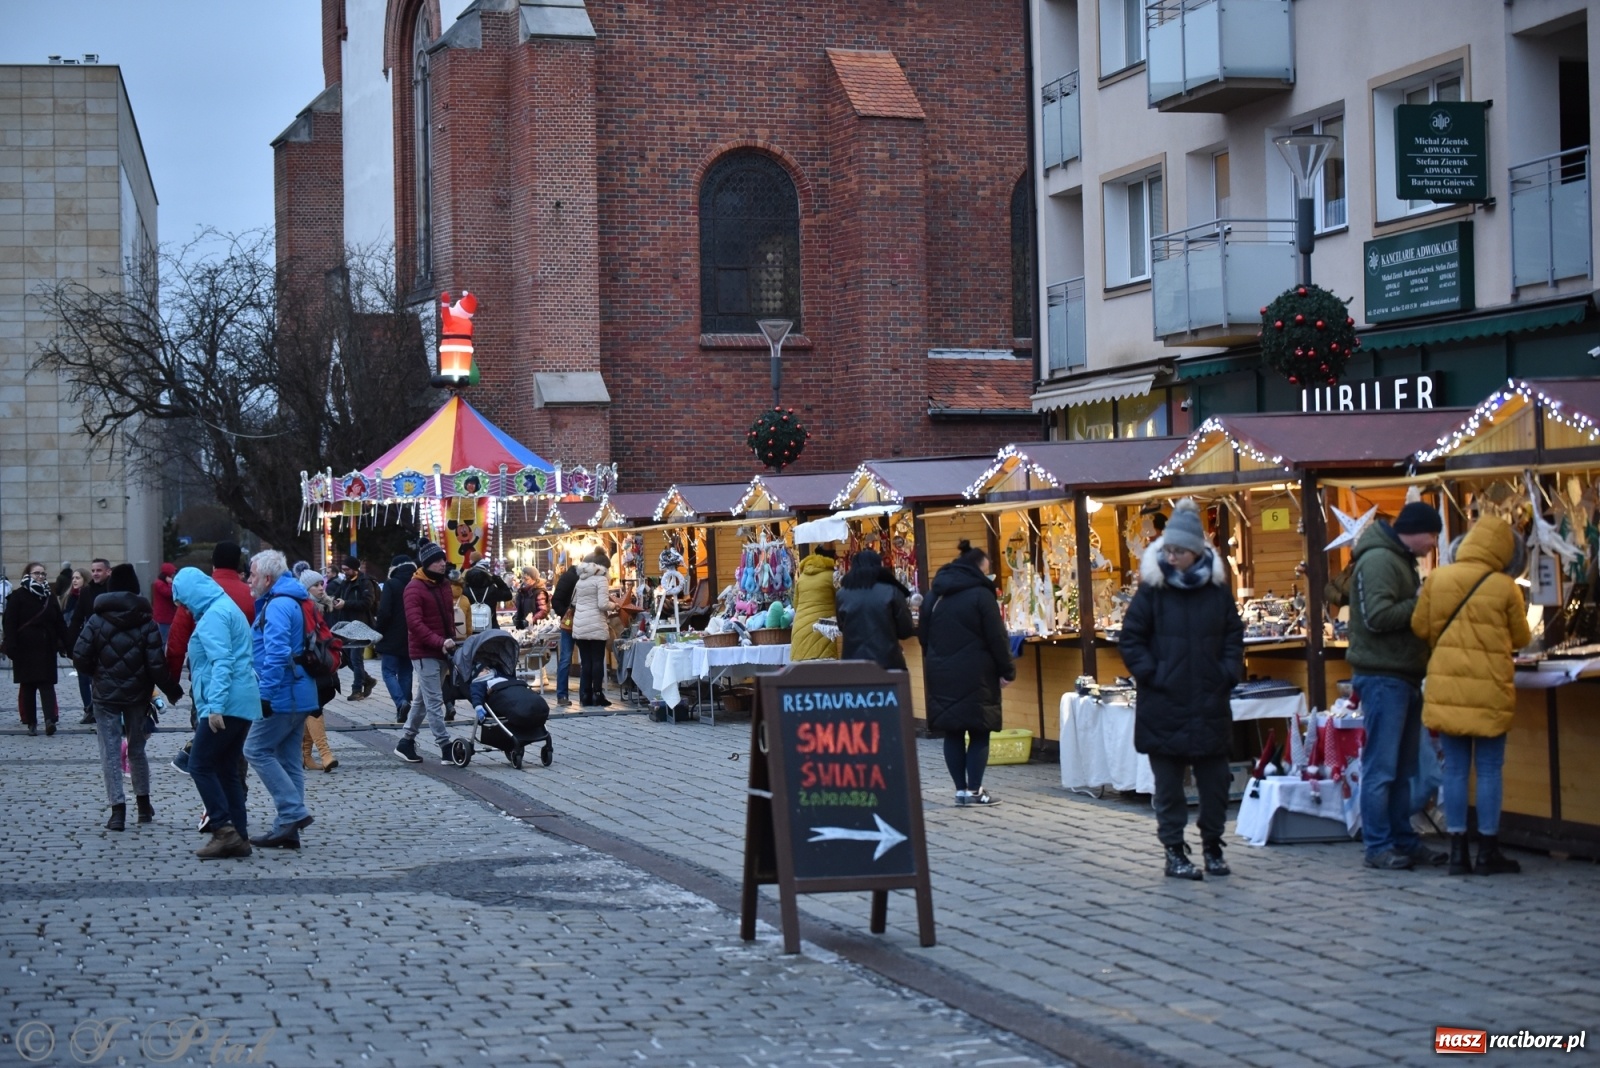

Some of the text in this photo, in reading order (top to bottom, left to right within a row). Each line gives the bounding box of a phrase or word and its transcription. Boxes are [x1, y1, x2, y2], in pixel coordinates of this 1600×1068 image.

[1441, 137, 1469, 146] Zientek
[1416, 158, 1469, 166] Stefan Zientek
[1411, 178, 1475, 187] Barbara Gniewek
[1381, 239, 1458, 266] KANCELARIE ADWOKACKIE
[1271, 511, 1279, 522] 6
[783, 691, 898, 713] RESTAURACJA
[796, 721, 881, 756] SMAKI
